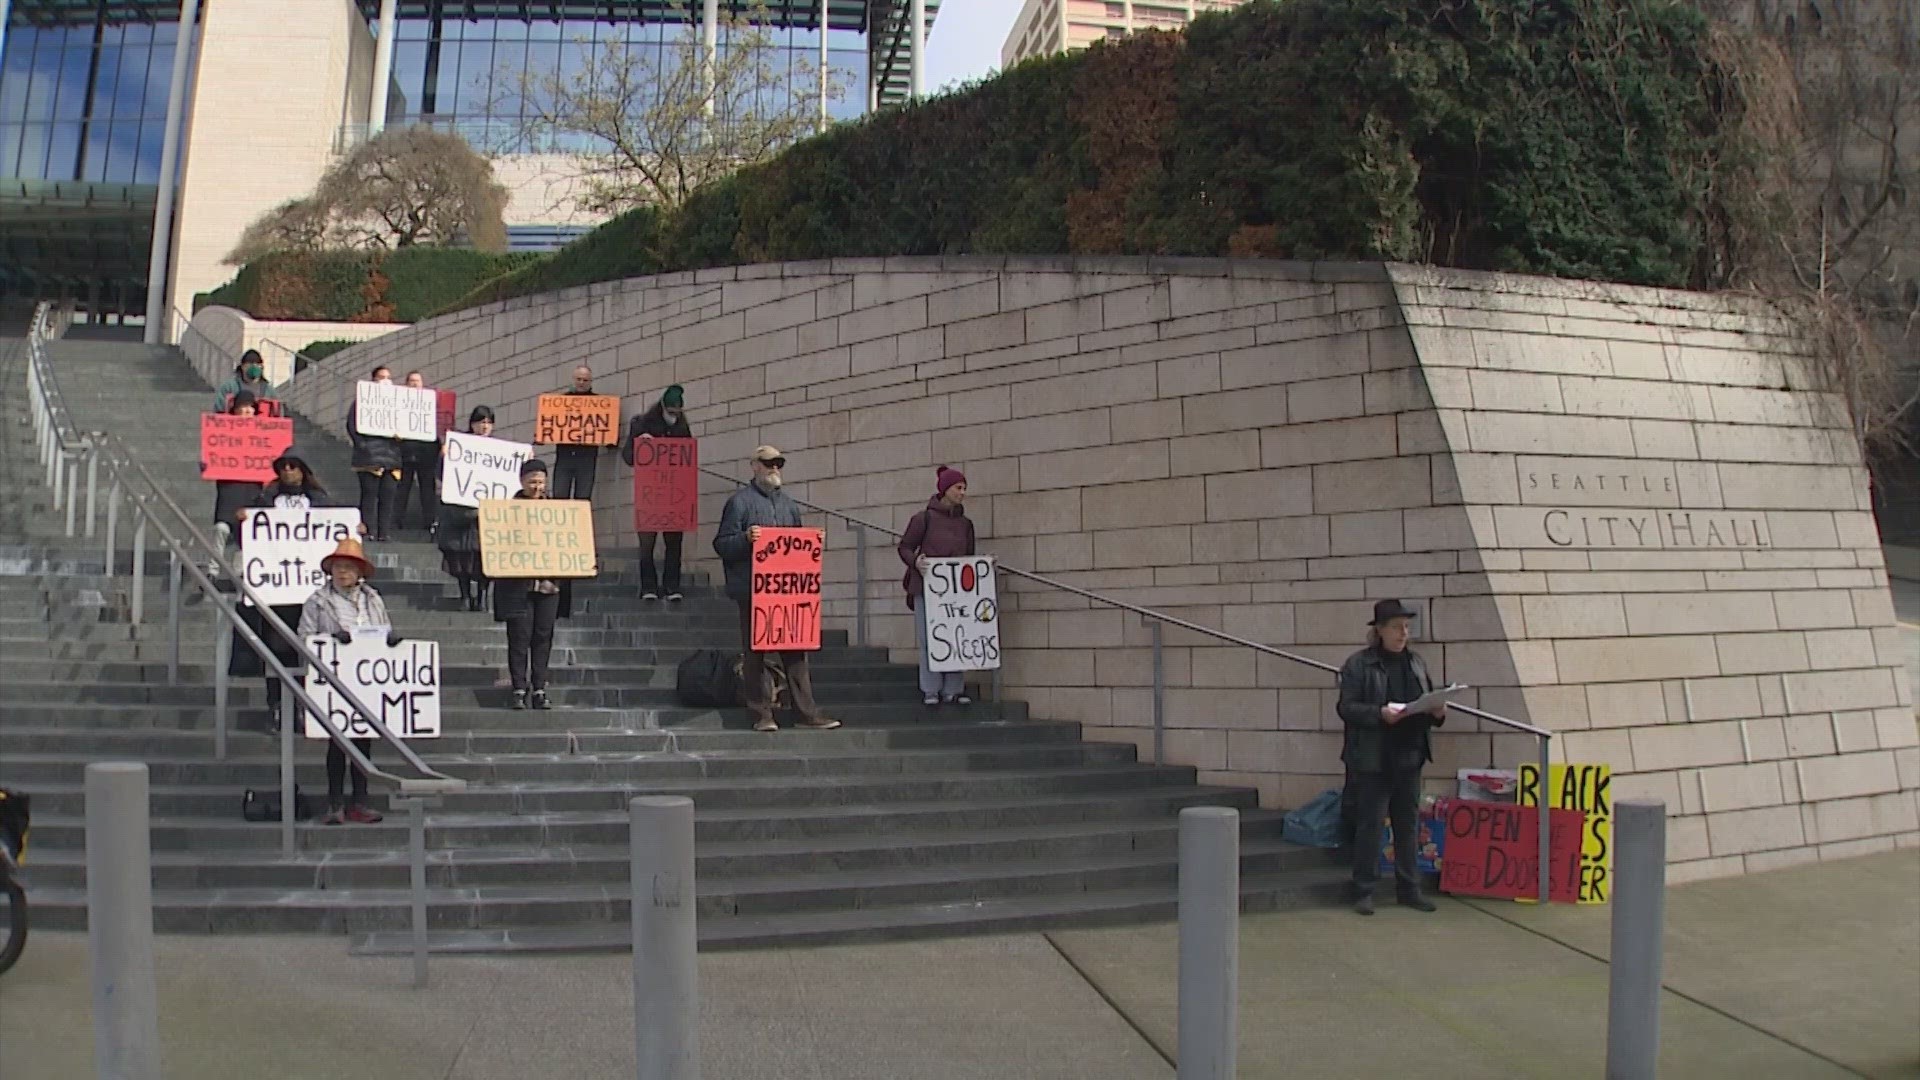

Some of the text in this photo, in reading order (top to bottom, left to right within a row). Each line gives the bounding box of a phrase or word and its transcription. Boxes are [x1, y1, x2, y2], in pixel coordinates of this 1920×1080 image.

[542, 397, 611, 409] HOUSING
[360, 407, 432, 434] PEOPLE DIE
[541, 413, 609, 428] HUMAN
[207, 434, 242, 448] OPEN
[542, 427, 611, 443] RIGHT
[208, 451, 239, 467] RED
[636, 441, 693, 467] OPEN
[454, 465, 508, 500] Van
[651, 469, 678, 484] THE
[1529, 472, 1673, 492] SEATTLE
[642, 485, 687, 506] RED
[251, 511, 349, 542] Andria
[483, 506, 580, 527] WITHOUT
[1543, 509, 1768, 546] CITY HALL
[484, 529, 580, 548] SHELTER
[486, 551, 593, 572] PEOPLE DIE
[754, 572, 821, 594] DESERVES
[929, 560, 990, 596] STOP
[753, 601, 820, 646] DIGNITY
[356, 643, 436, 686] could
[328, 690, 434, 735] be ME
[1449, 805, 1521, 842] OPEN
